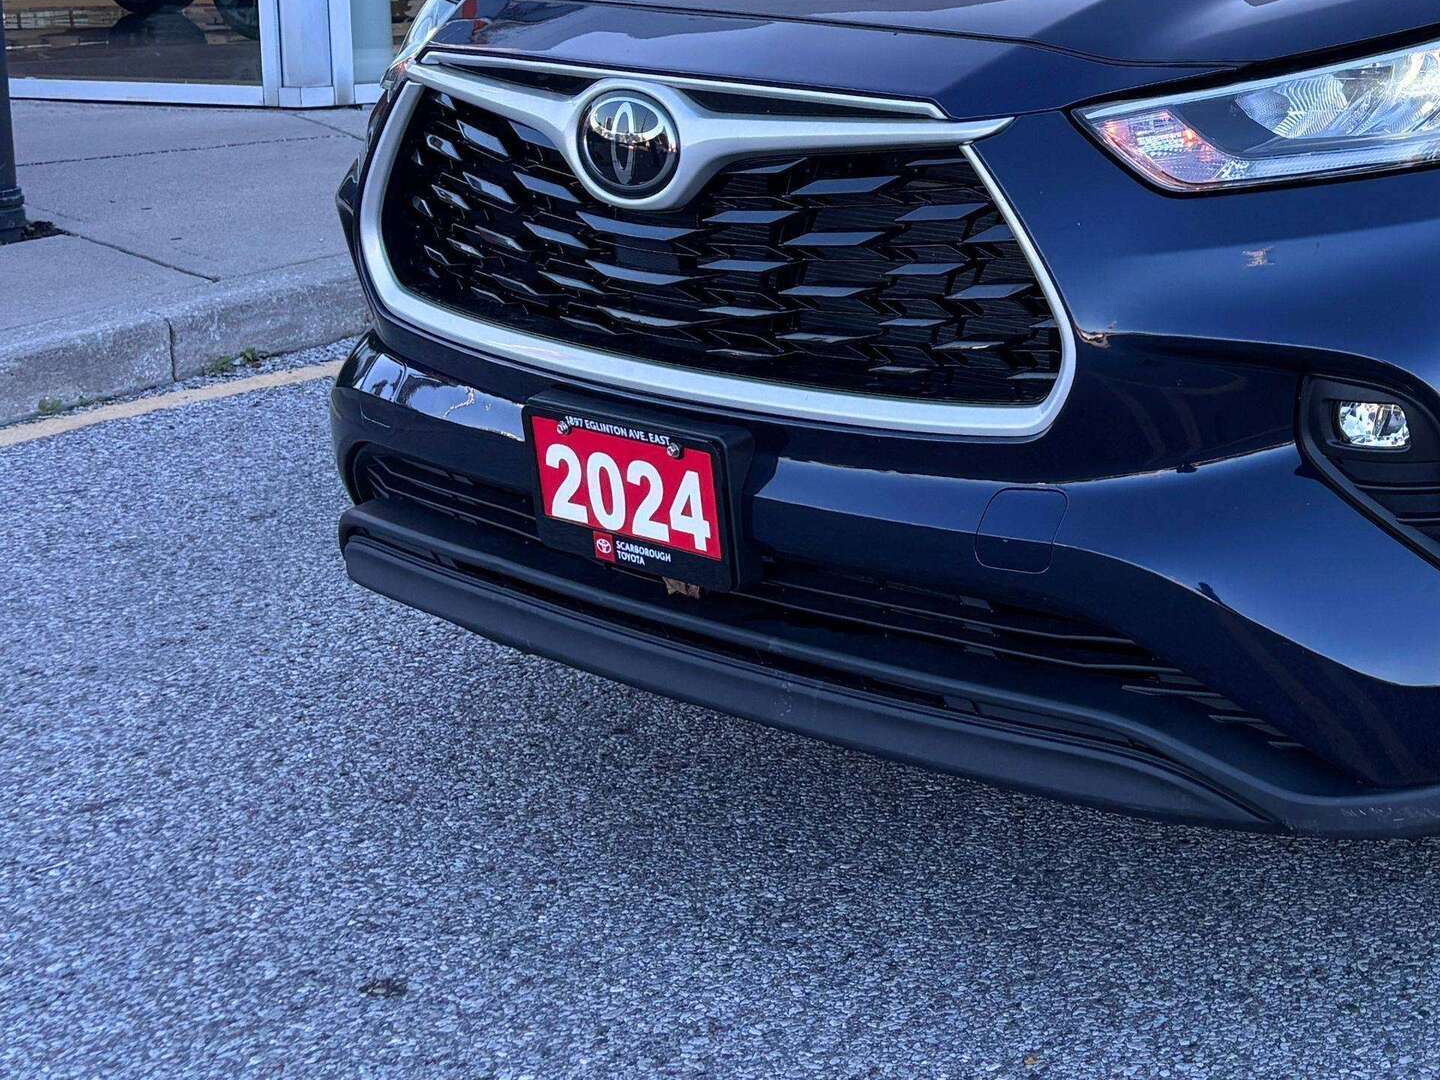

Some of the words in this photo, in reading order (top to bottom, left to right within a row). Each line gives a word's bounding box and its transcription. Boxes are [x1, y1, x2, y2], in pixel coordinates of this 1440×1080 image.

[584, 419, 628, 438] EGLINTON
[628, 428, 648, 441] AVE.
[648, 434, 670, 446] EAST
[545, 443, 711, 552] 2024
[615, 540, 672, 563] SCARBOROUGH
[617, 550, 645, 566] TOYOTA
